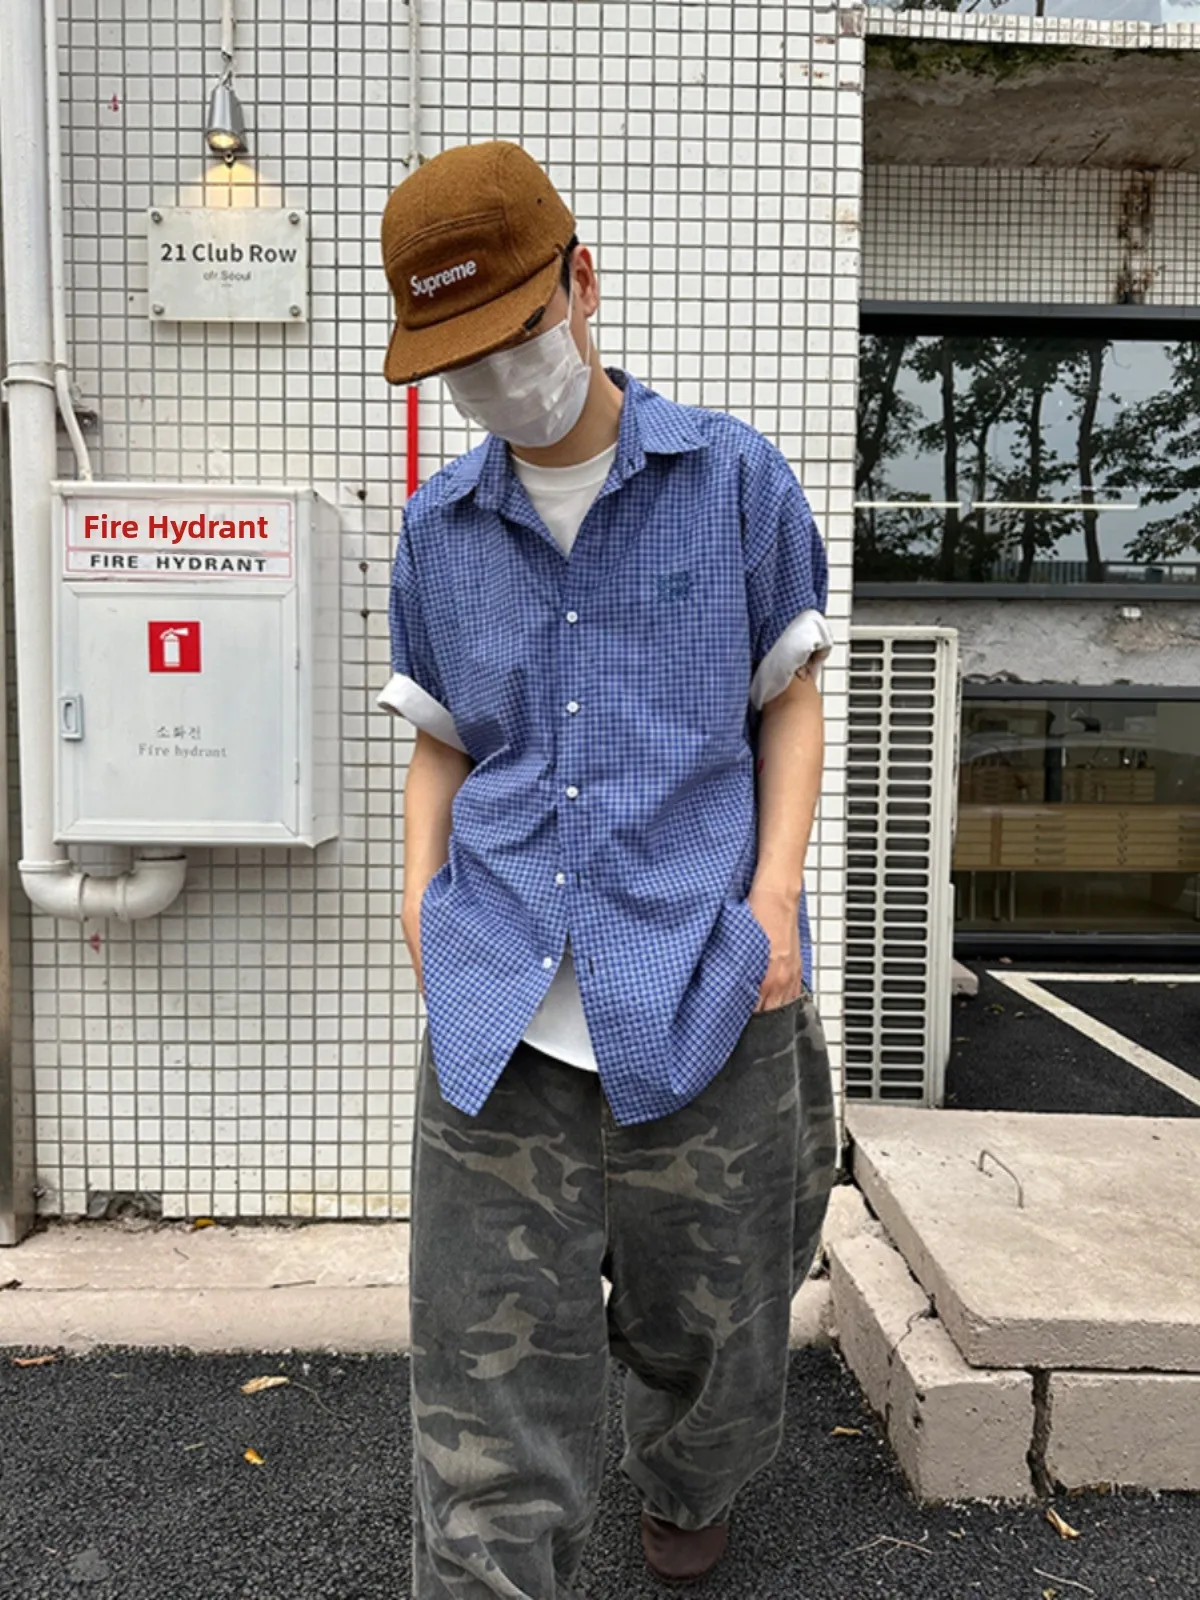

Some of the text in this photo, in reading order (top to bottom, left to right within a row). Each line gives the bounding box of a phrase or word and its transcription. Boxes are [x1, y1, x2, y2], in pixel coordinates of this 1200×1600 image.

[160, 242, 297, 262] 21 Club Row
[410, 260, 477, 298] Supreme
[84, 513, 269, 545] Fire Hydrant
[90, 554, 267, 572] FIRE HYDRANT
[157, 725, 201, 740] 소화전
[138, 743, 227, 759] Fire hydrant
